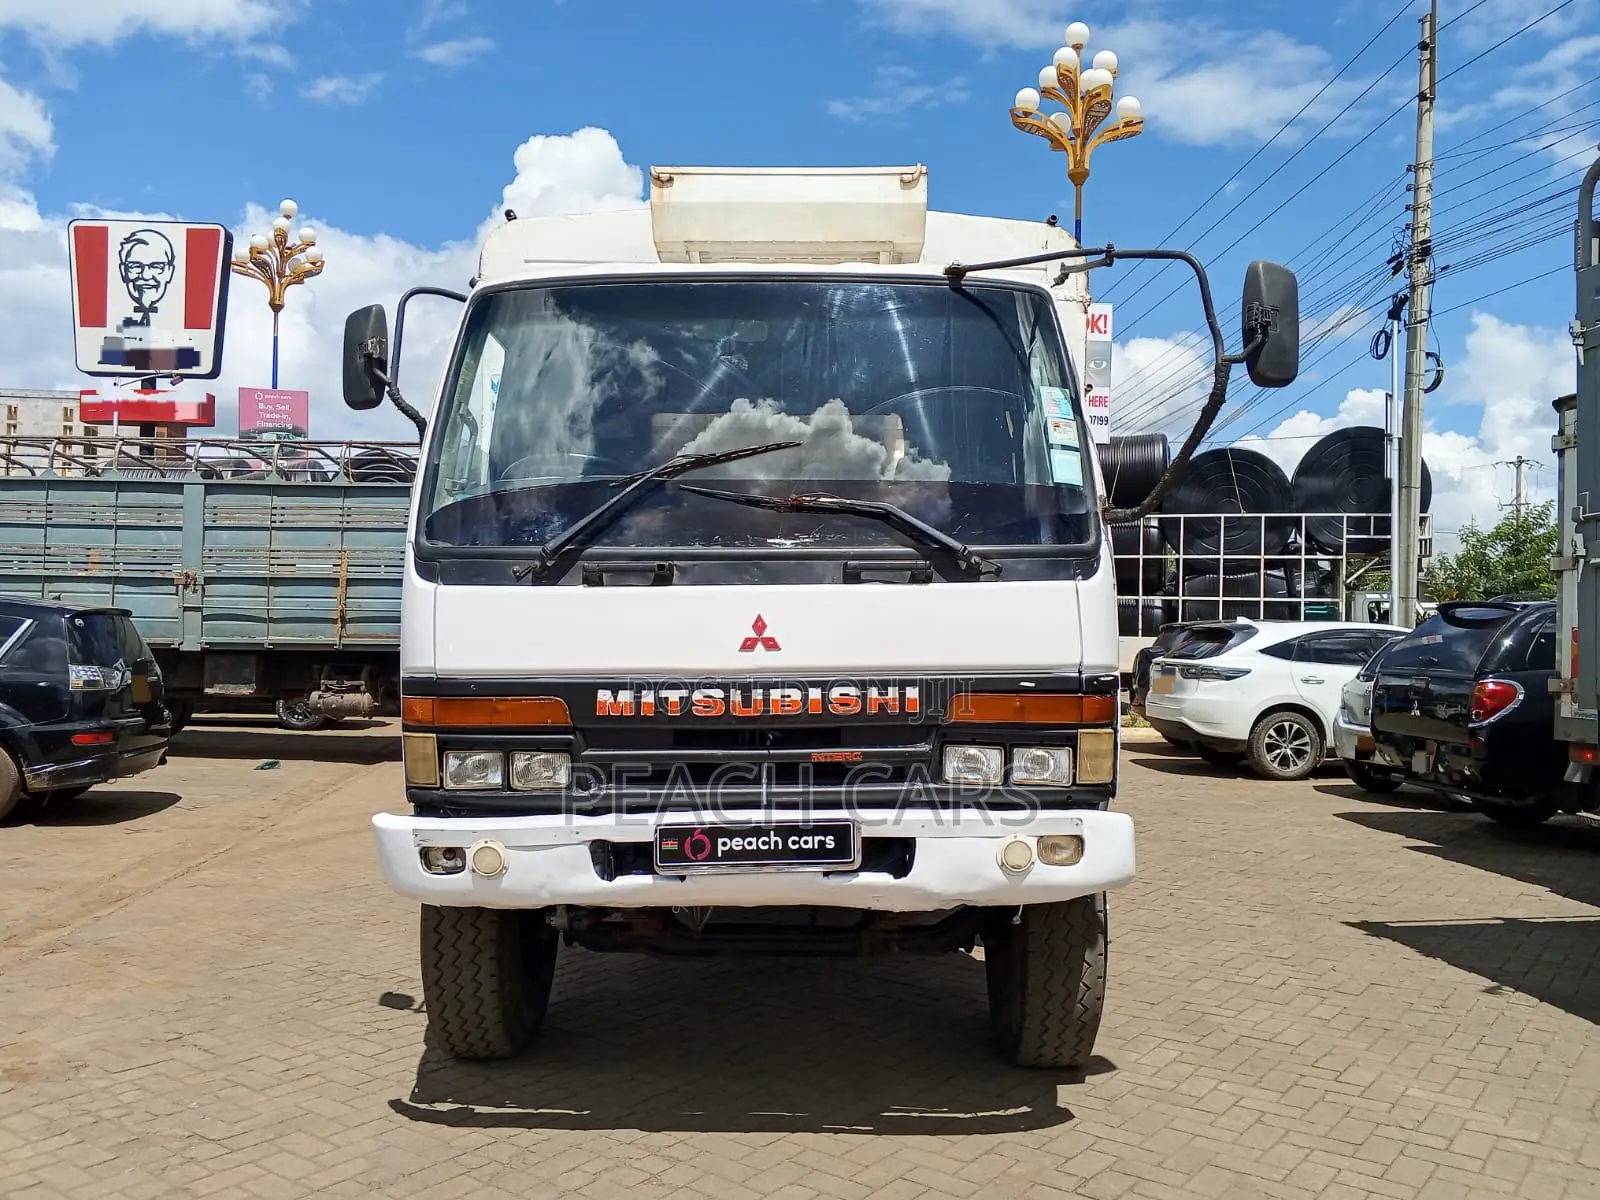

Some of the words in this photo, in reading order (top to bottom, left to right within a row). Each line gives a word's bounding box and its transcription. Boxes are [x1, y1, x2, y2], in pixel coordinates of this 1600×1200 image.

[1086, 313, 1108, 335] K!
[258, 402, 275, 411] Buy,
[276, 403, 292, 412] Sell,
[1088, 395, 1109, 408] HERE
[259, 411, 291, 420] Trade-in,
[256, 420, 293, 430] Financing
[596, 686, 920, 717] MITSUBISHI
[717, 830, 783, 858] peach
[787, 834, 835, 850] cars
